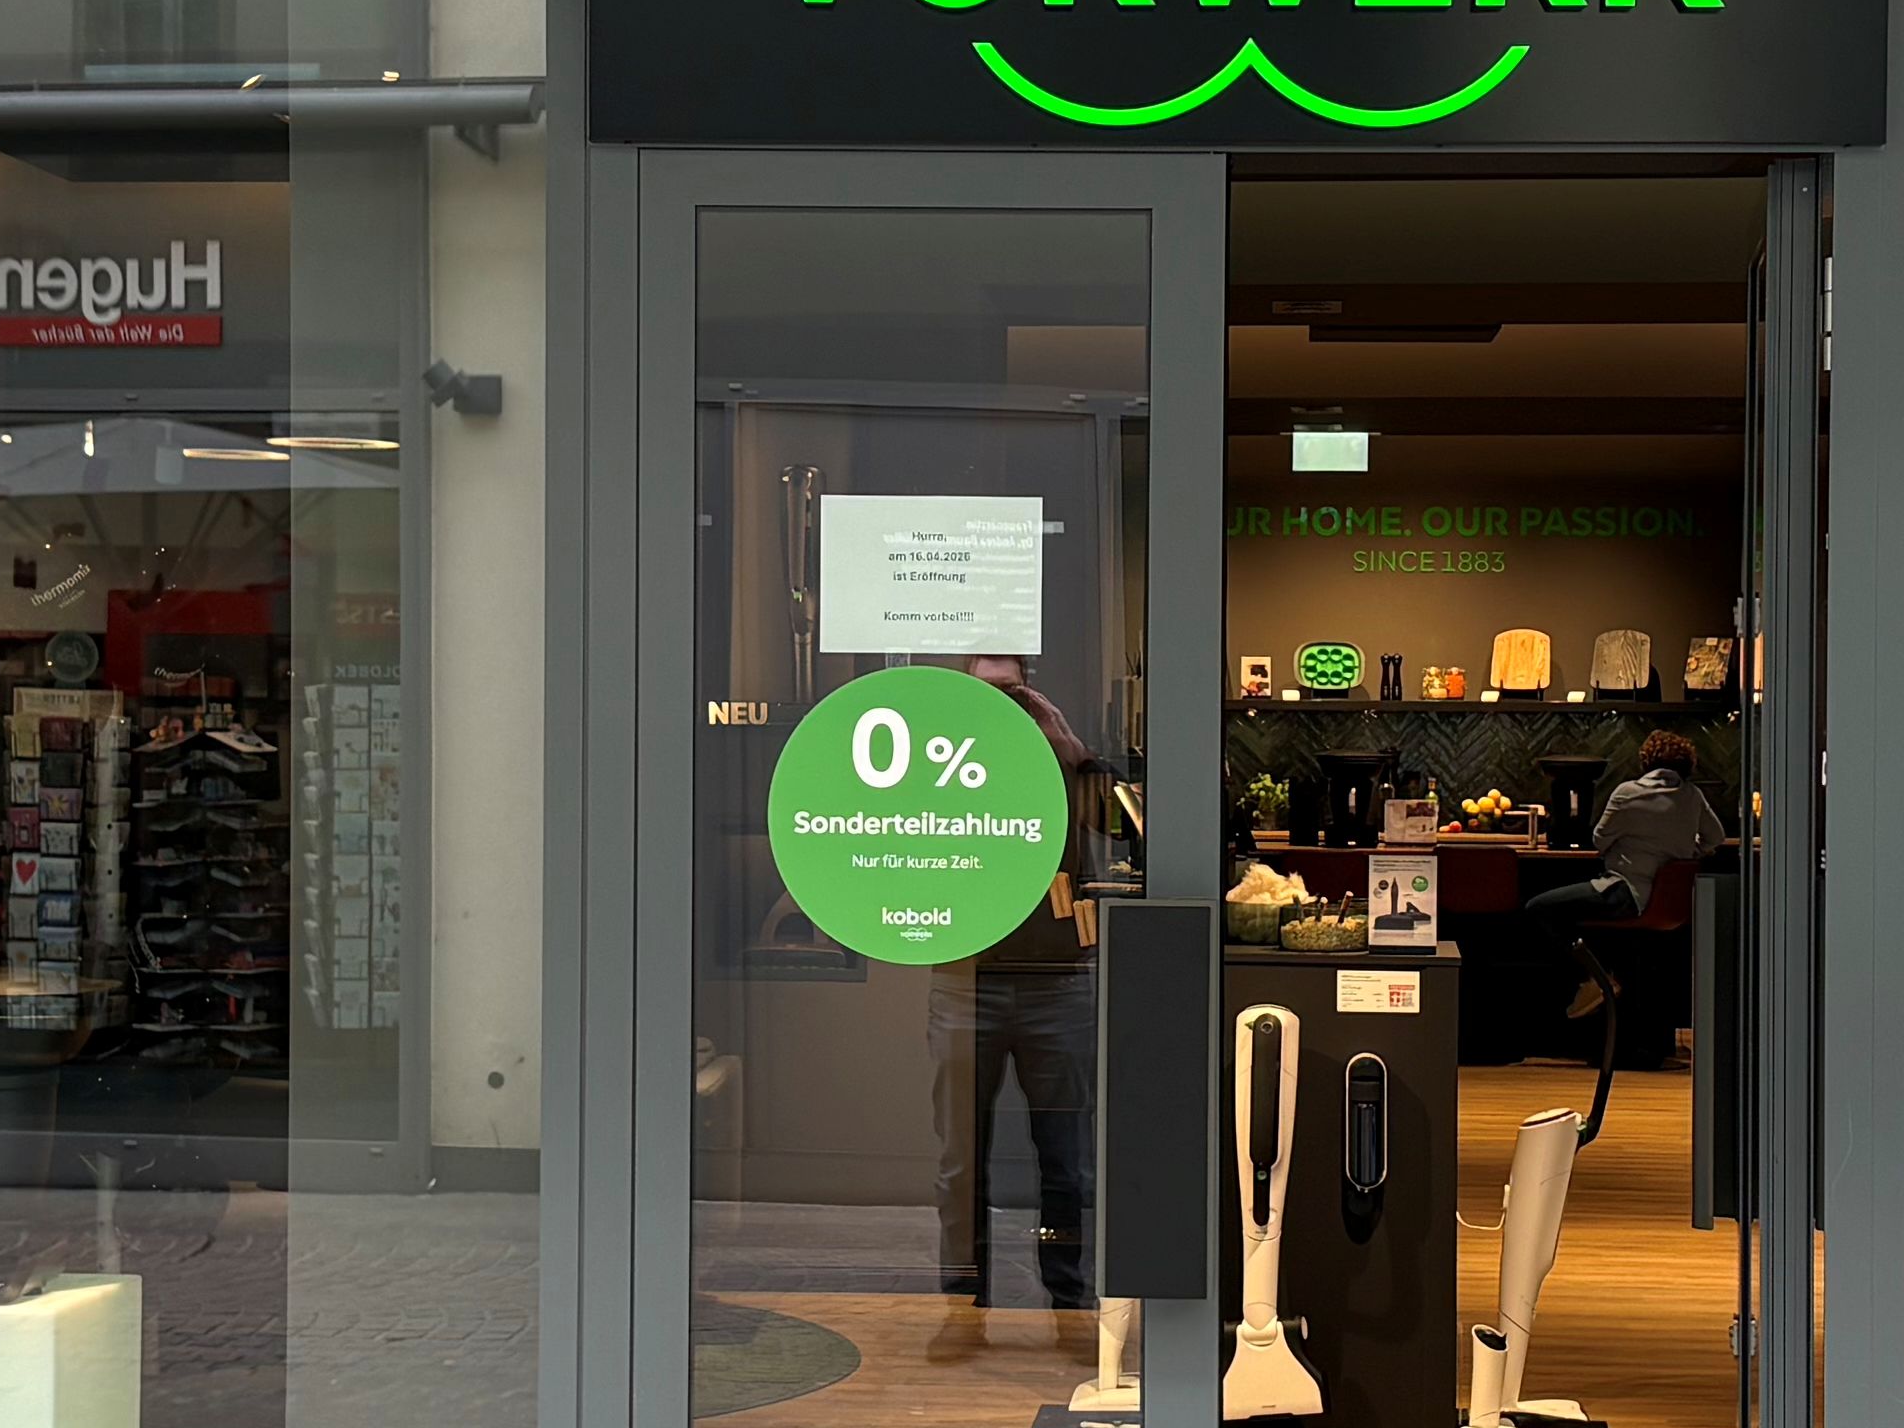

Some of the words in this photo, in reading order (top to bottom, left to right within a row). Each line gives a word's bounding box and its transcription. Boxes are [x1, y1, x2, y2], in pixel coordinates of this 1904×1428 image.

[1227, 506, 1272, 537] UR
[1282, 506, 1412, 537] HOME.
[1421, 506, 1508, 537] OUR
[1520, 507, 1705, 538] PASSION.
[1352, 550, 1434, 573] SINCE
[1441, 551, 1506, 574] 1883
[910, 571, 966, 584] Eröffnung
[884, 611, 921, 622] Komm
[708, 700, 768, 725] NEU
[851, 706, 912, 789] 0
[925, 736, 988, 790] %
[793, 811, 1043, 843] Sonderteilzahlung
[851, 854, 880, 868] Nur
[882, 854, 905, 869] für
[906, 855, 948, 869] kurze
[950, 855, 984, 870] Zeit.
[881, 906, 952, 926] kobold
